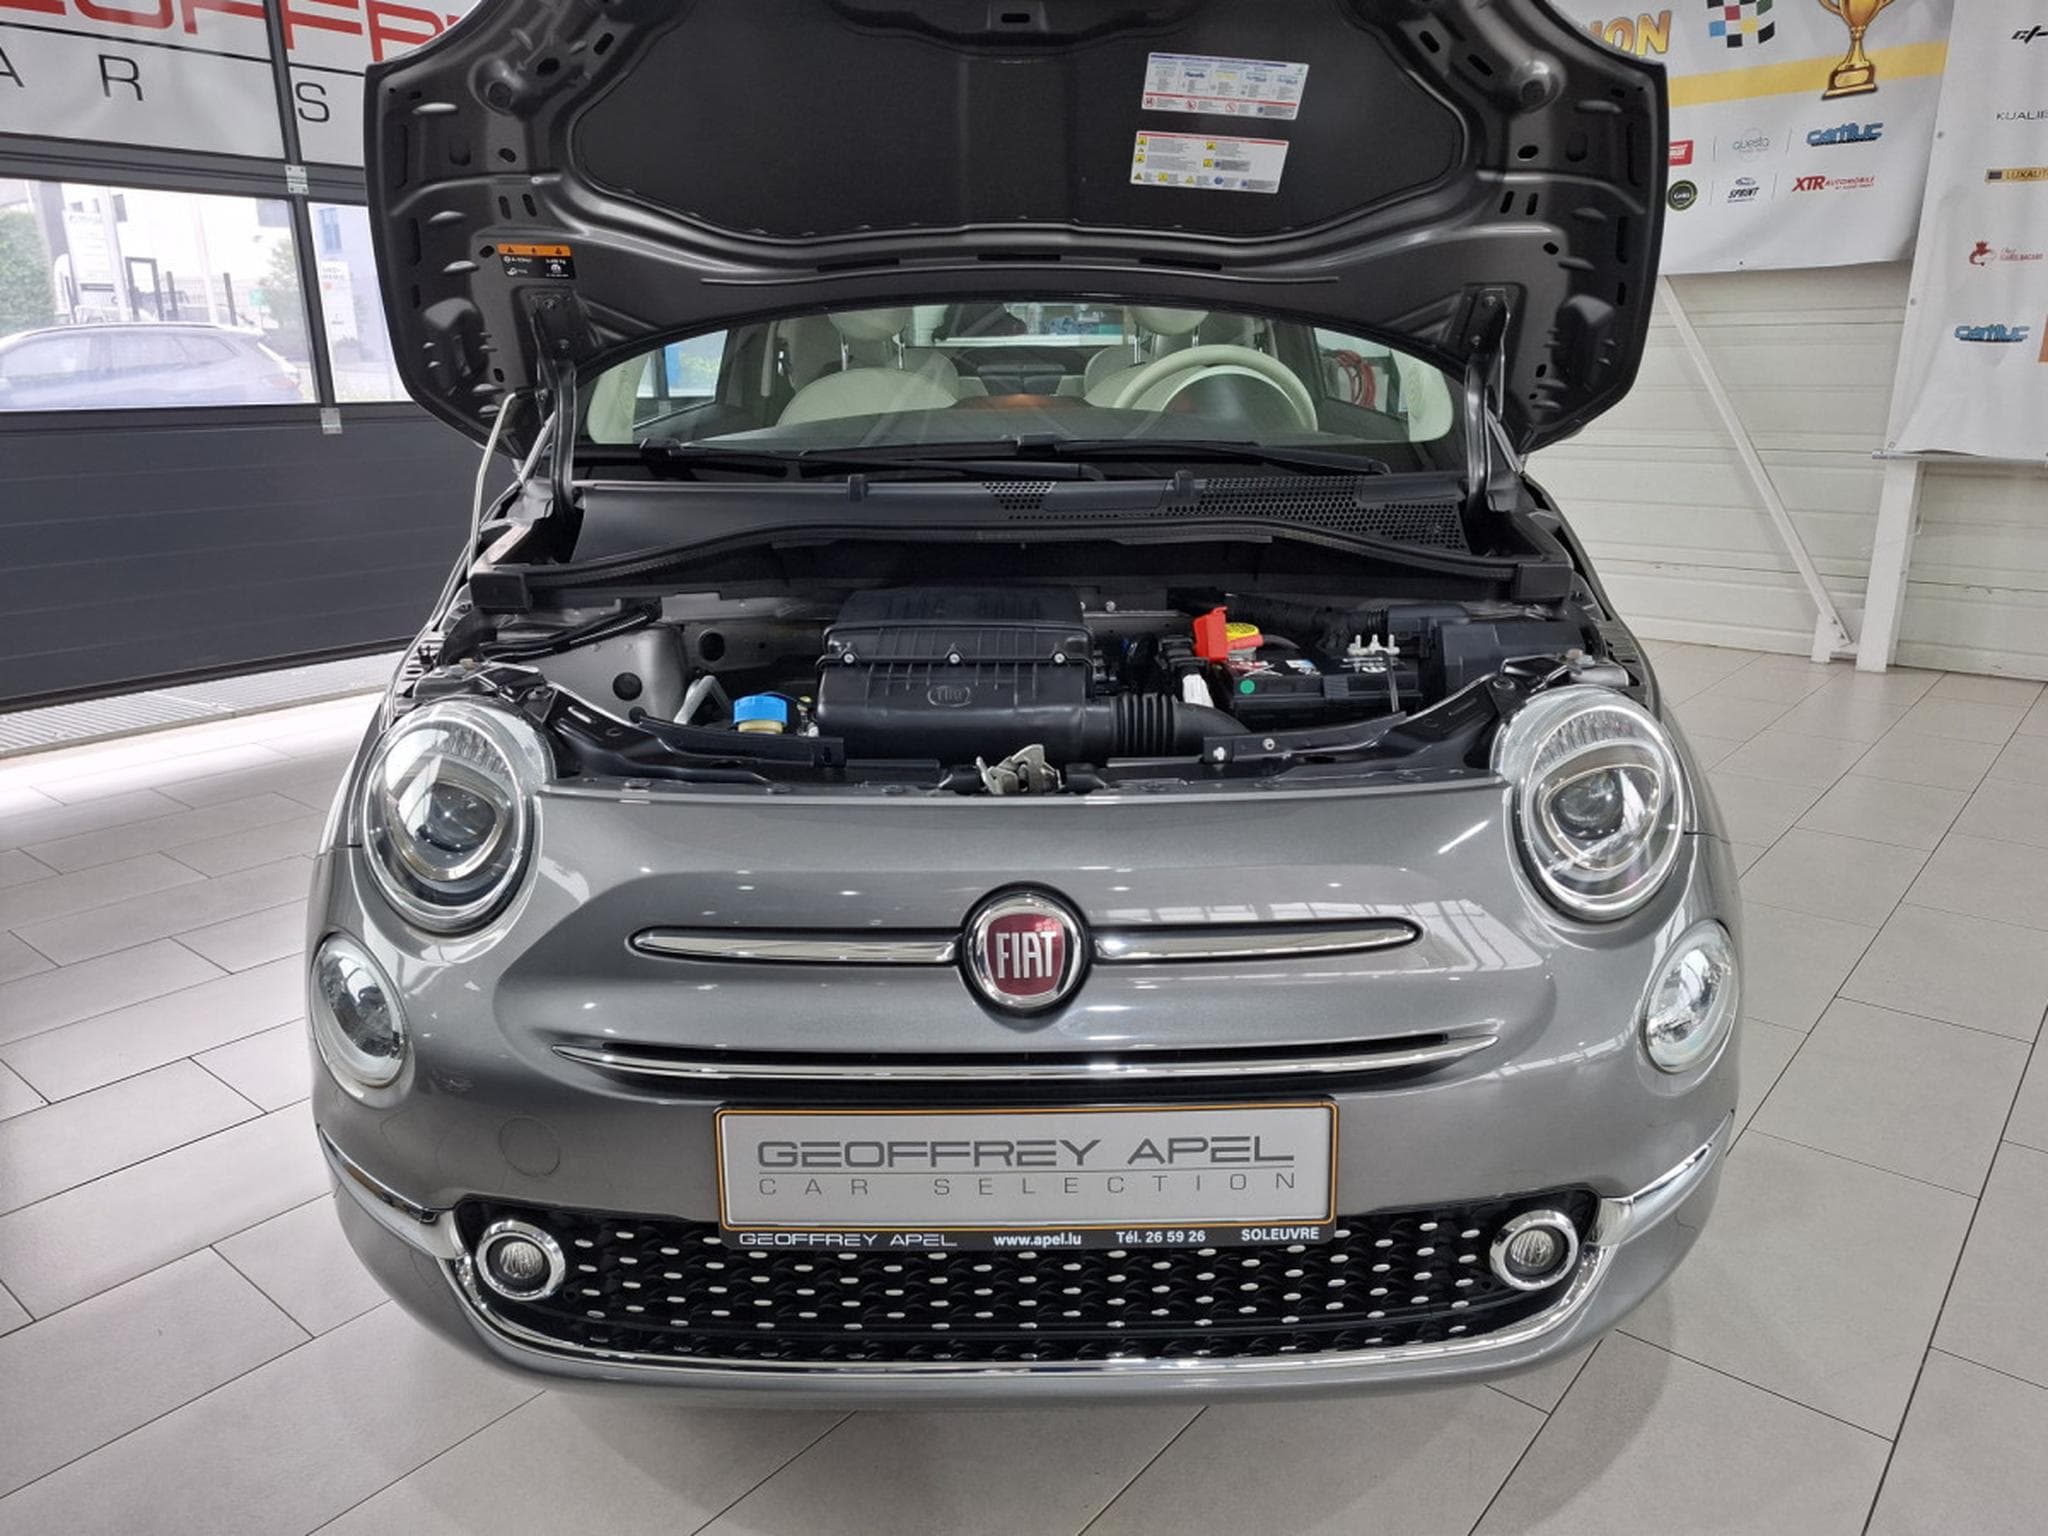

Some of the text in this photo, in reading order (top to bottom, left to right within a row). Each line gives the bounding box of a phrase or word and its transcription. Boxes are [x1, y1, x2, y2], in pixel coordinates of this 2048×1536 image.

[1791, 175, 1826, 192] XTR
[995, 931, 1057, 979] FIAT
[758, 1136, 1294, 1168] GEOFFREY APEL
[759, 1172, 1295, 1196] CAR SELECTION
[739, 1227, 1320, 1247] GEOFFREY APEL www.apel.lu Tél. 26 59 26 SOLEUVRE
